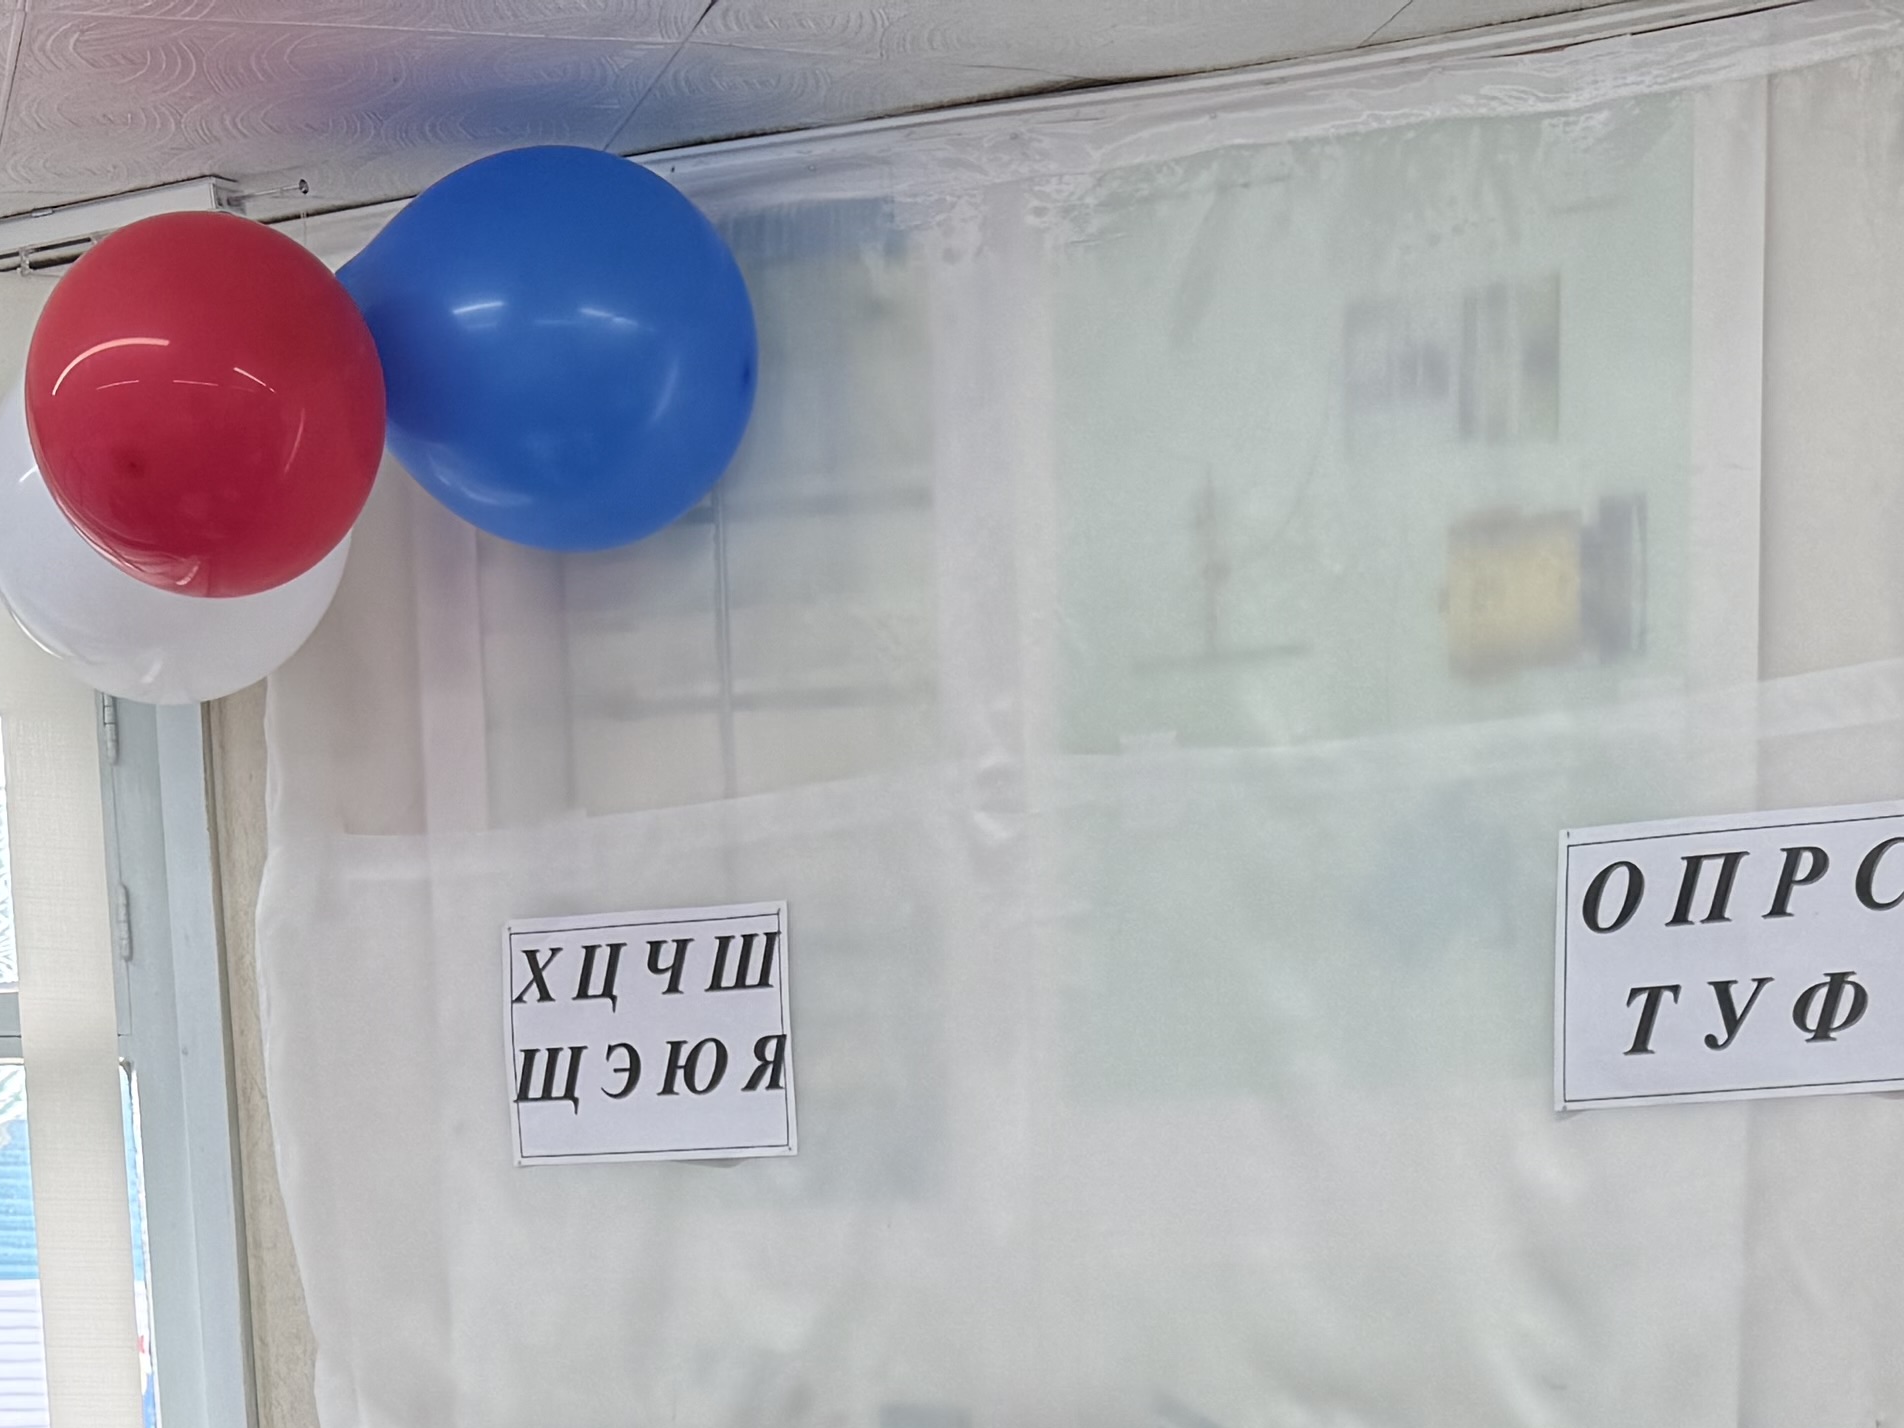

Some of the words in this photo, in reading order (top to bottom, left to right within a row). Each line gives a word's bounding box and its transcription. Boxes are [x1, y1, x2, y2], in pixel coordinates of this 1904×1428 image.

[1582, 861, 1645, 934] О
[1665, 850, 1750, 927] П
[1761, 846, 1830, 919] Р
[1623, 984, 1682, 1056] Т
[1704, 977, 1775, 1051] У
[1792, 971, 1868, 1043] Ф
